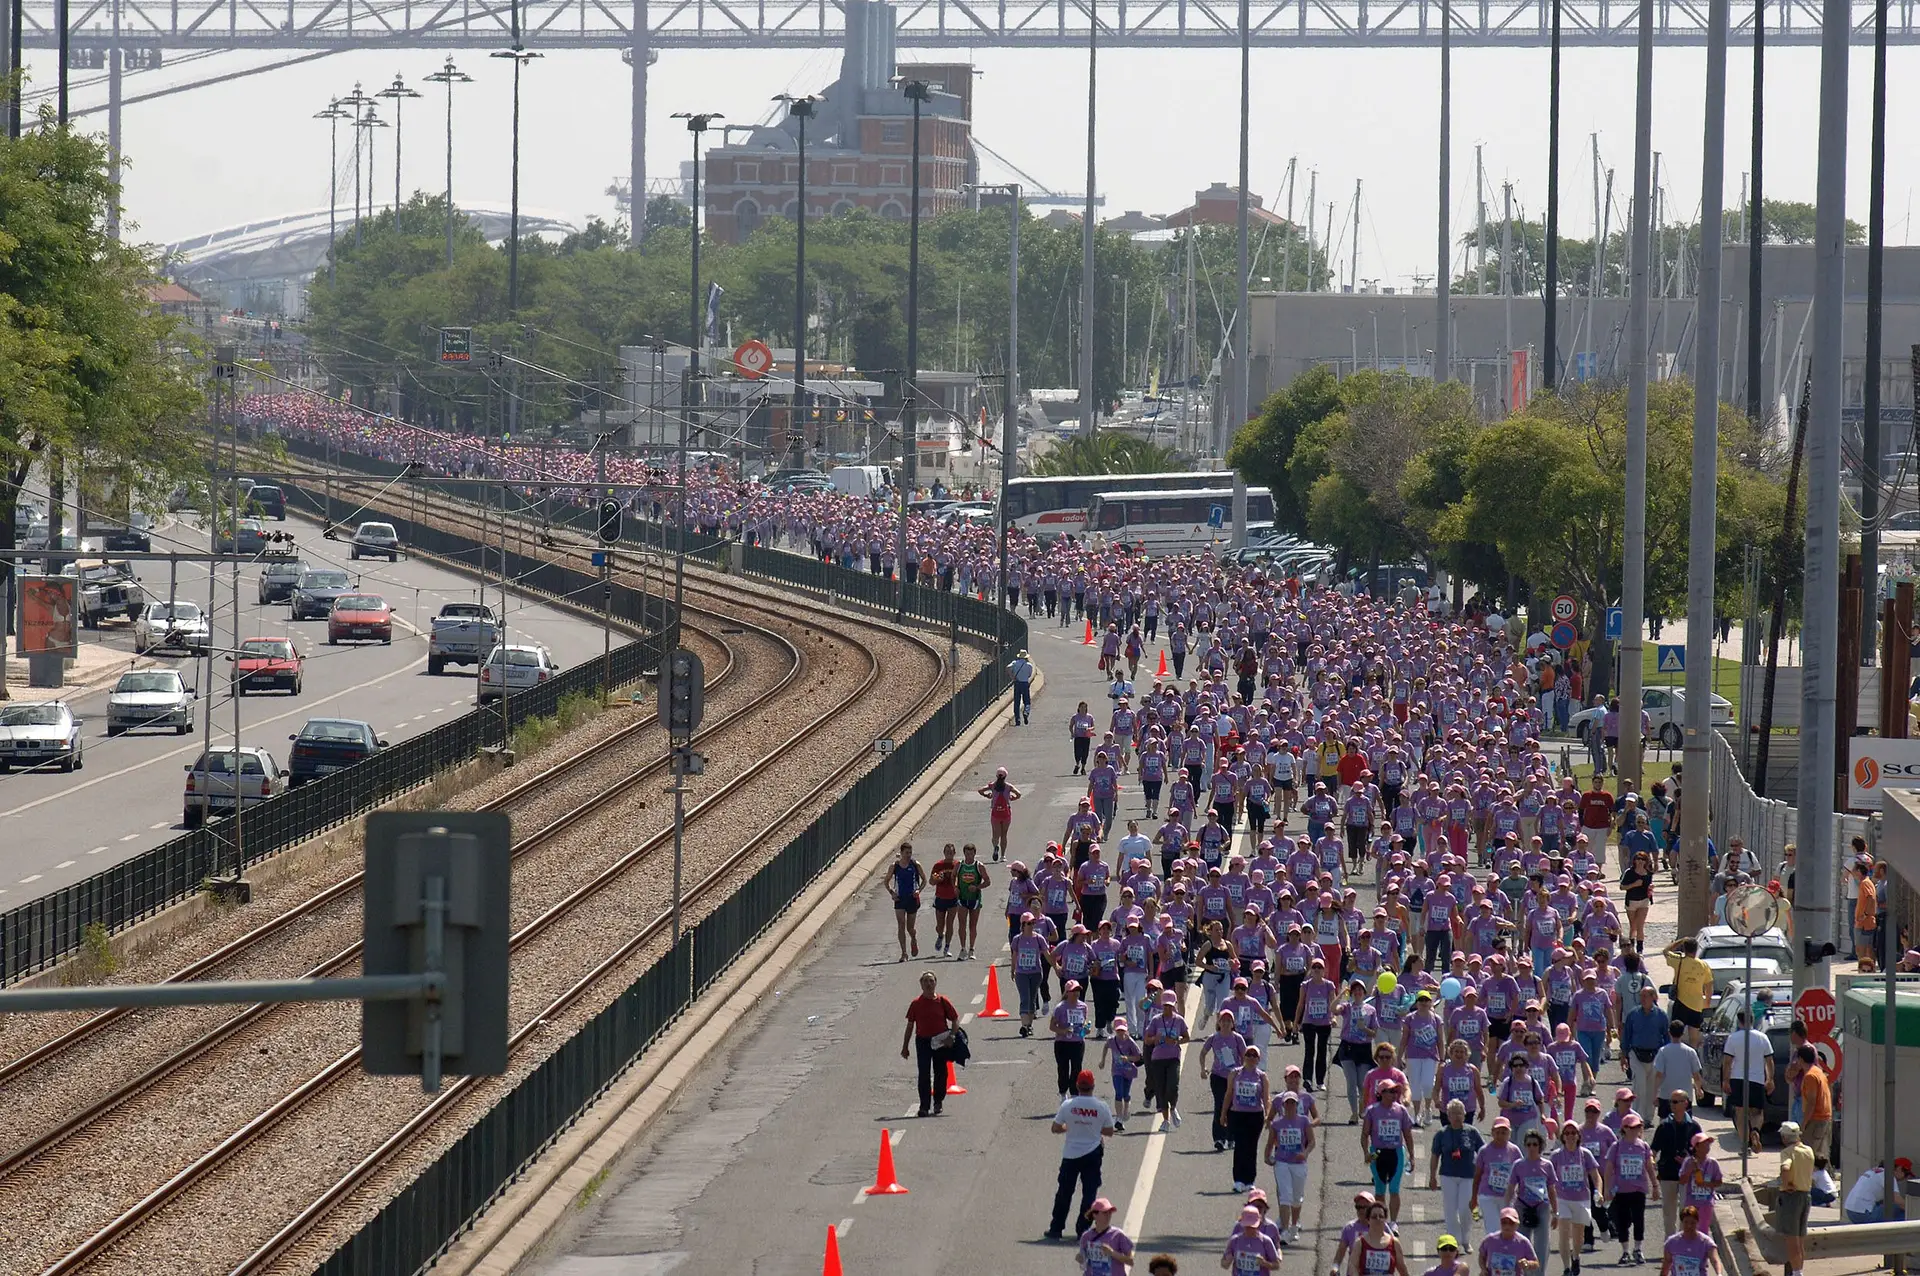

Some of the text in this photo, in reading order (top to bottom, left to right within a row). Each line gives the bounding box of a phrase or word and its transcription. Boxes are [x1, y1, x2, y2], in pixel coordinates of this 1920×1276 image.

[216, 365, 234, 378] 02
[1556, 603, 1572, 615] 50
[880, 741, 887, 750] 6
[1795, 1004, 1836, 1022] STOP
